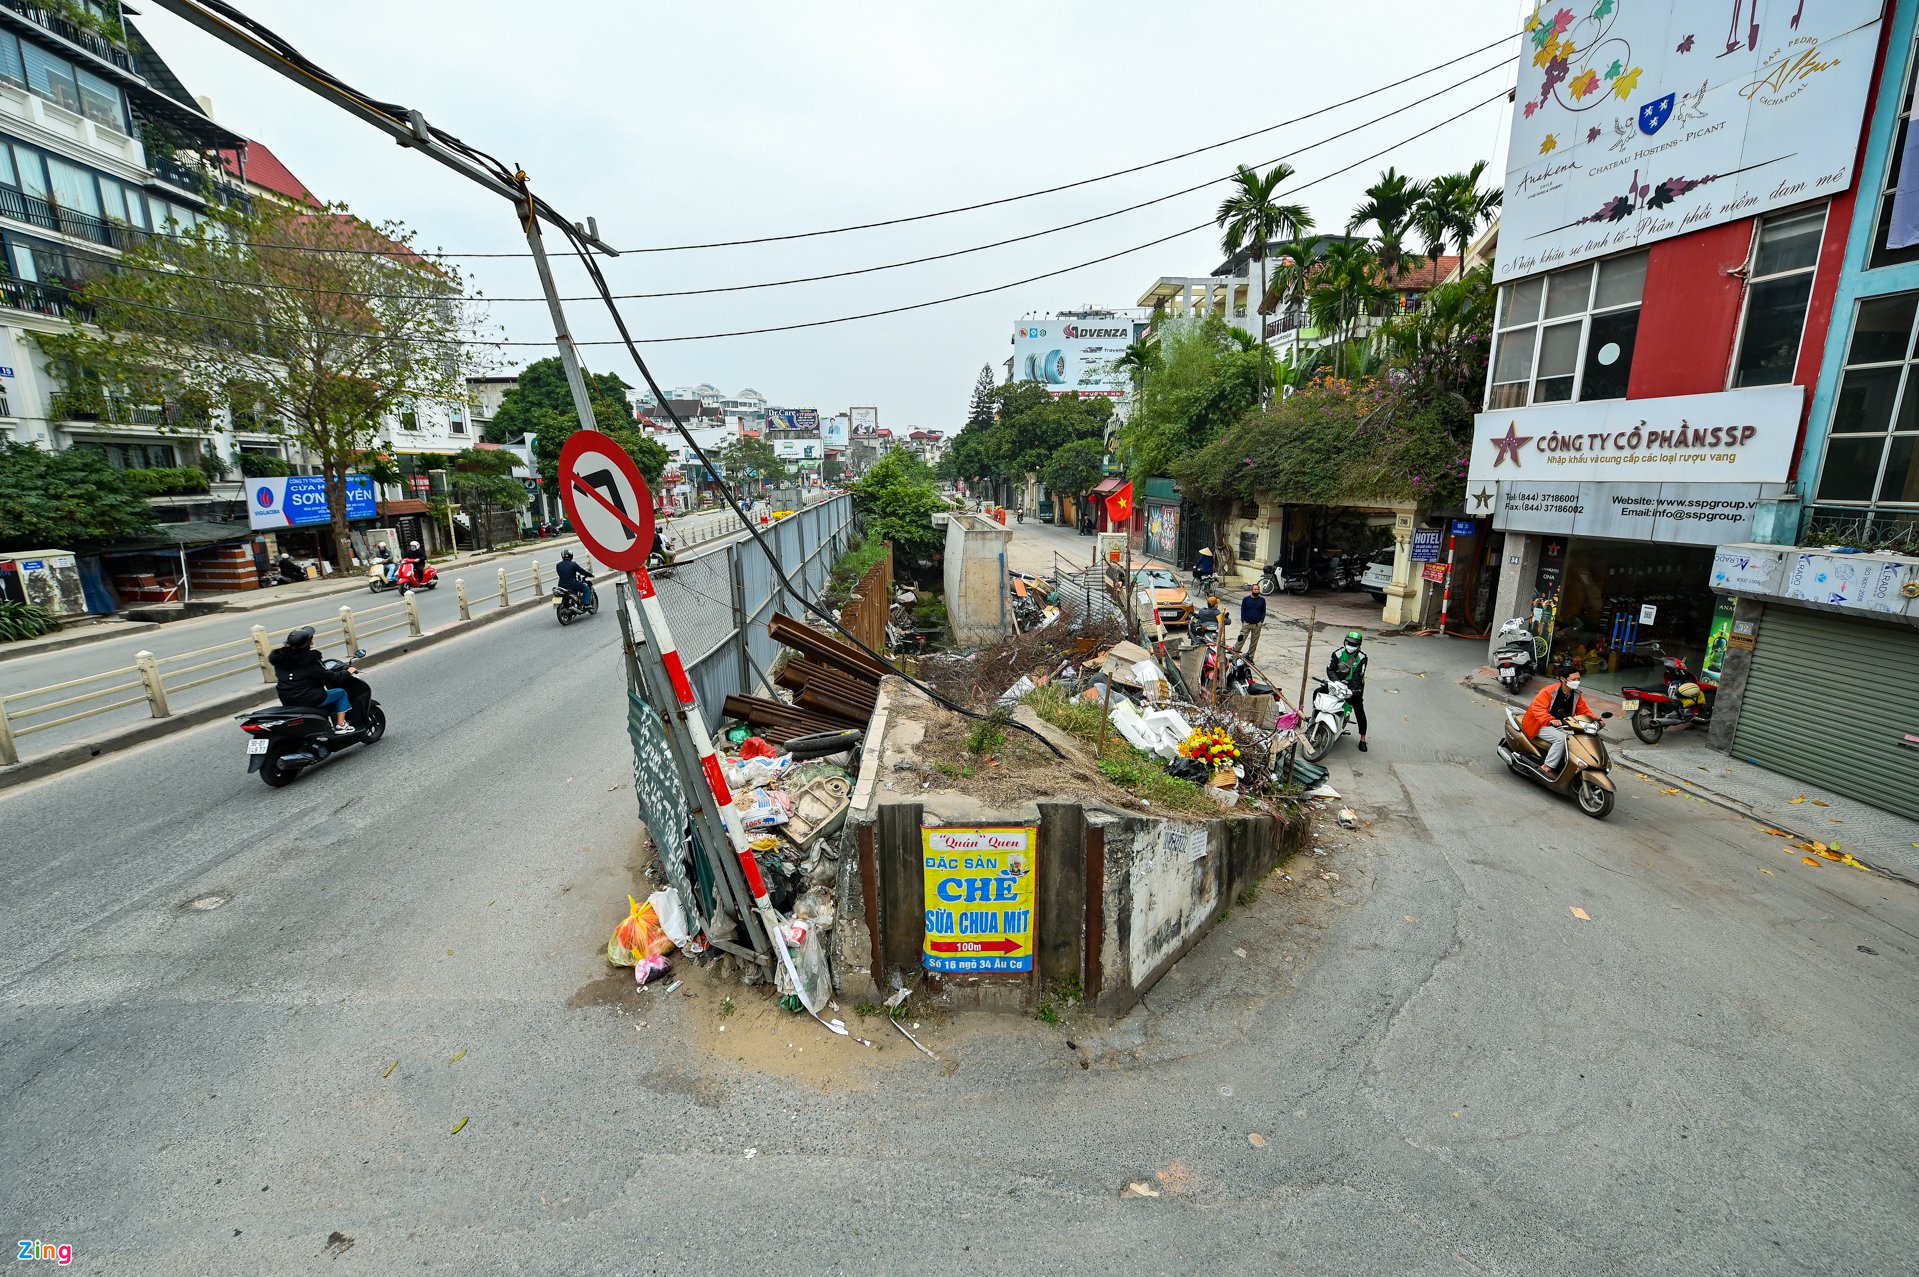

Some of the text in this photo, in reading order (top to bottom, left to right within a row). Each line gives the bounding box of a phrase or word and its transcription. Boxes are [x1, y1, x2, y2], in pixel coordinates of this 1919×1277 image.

[1763, 36, 1819, 65] SAN PEDRO
[1589, 156, 1631, 177] CHATEAU
[1686, 121, 1727, 142] PICANT
[1502, 256, 1536, 275] Nhập
[1585, 232, 1609, 251] tinh
[1678, 202, 1712, 233] phối
[1769, 179, 1809, 200] đam
[1816, 166, 1847, 187] mê
[1063, 324, 1128, 339] ADVENZA
[1, 367, 12, 375] 15
[1536, 430, 1584, 452] CÔNG
[1588, 432, 1612, 450] TY
[1613, 419, 1647, 450] CỔ
[1547, 456, 1566, 465] Nhập
[1568, 453, 1588, 464] khẩu
[1623, 452, 1640, 465] cấp
[1641, 453, 1658, 463] các
[1660, 452, 1677, 464] loại
[1678, 453, 1706, 464] rượu
[1709, 452, 1737, 463] vang
[291, 492, 325, 506] SƠN
[1505, 493, 1518, 501] Tel:
[1518, 492, 1539, 501] (844)
[1541, 494, 1580, 503] 37186001
[1612, 495, 1655, 506] Website:
[1504, 503, 1521, 511] Fax:
[1521, 502, 1543, 512] (844)
[1544, 505, 1585, 514] 37186002
[1414, 532, 1440, 544] HOTEL
[1738, 623, 1749, 633] 32
[988, 836, 1020, 849] Quen
[925, 854, 998, 872] ĐẶC SẢN
[925, 907, 1030, 935] SỮA CHUA MÍT
[956, 942, 982, 952] 100m
[929, 958, 1023, 971] Số 16 ngõ 34 Âu Cơ
